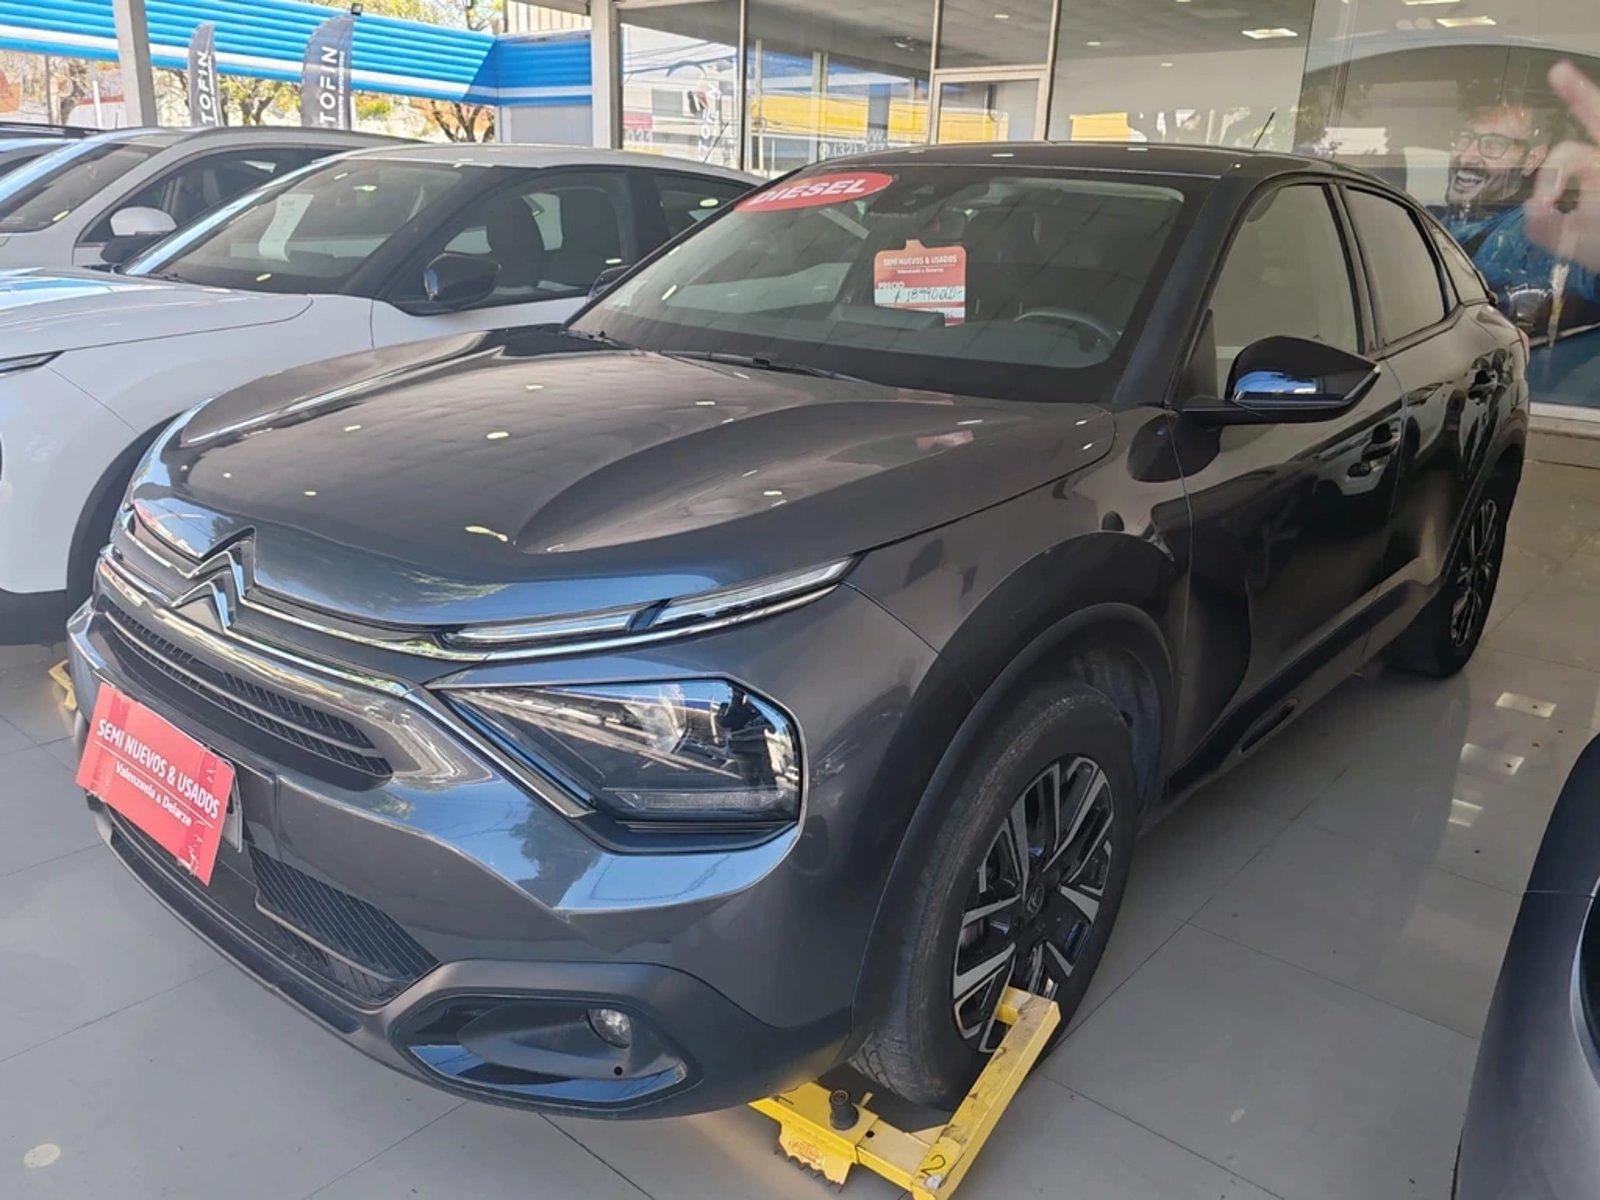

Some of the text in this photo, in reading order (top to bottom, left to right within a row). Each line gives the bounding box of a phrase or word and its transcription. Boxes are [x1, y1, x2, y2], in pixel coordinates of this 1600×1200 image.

[748, 178, 867, 205] DIESEL
[97, 719, 220, 819] SEMI NUEVOS & USADOS
[920, 1154, 946, 1176] 2
